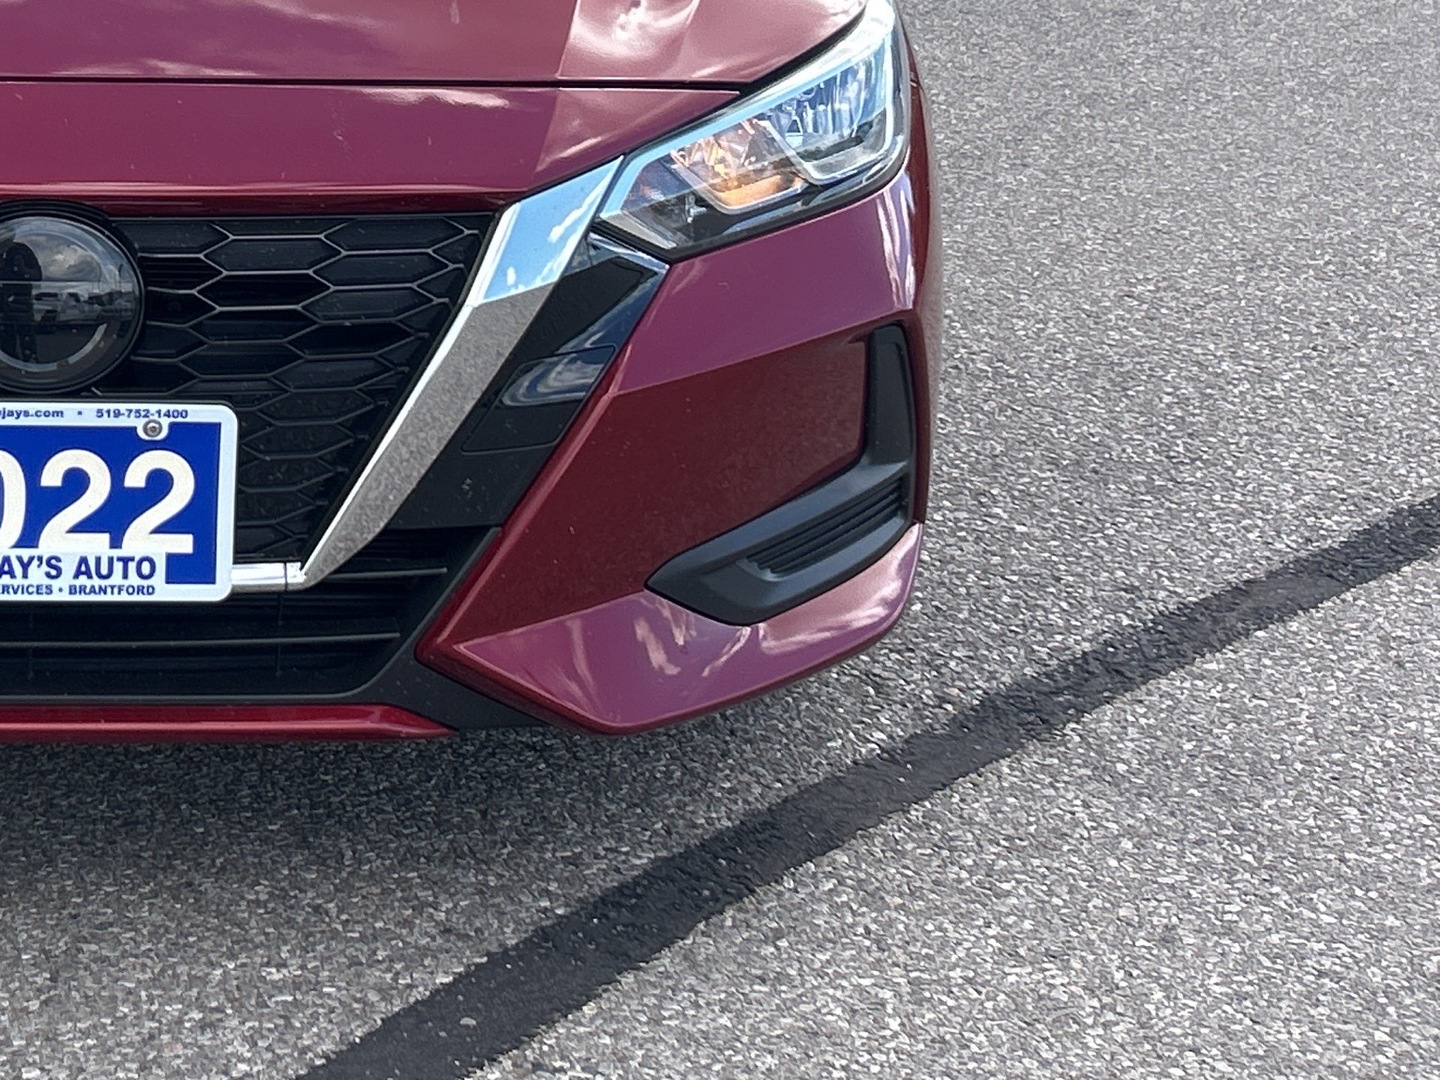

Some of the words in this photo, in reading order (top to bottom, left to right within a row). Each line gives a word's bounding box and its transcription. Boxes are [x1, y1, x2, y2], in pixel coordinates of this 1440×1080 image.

[95, 408, 189, 419] 519-752-1400
[72, 555, 157, 580] AUTO
[68, 584, 156, 596] BRANTFORD
